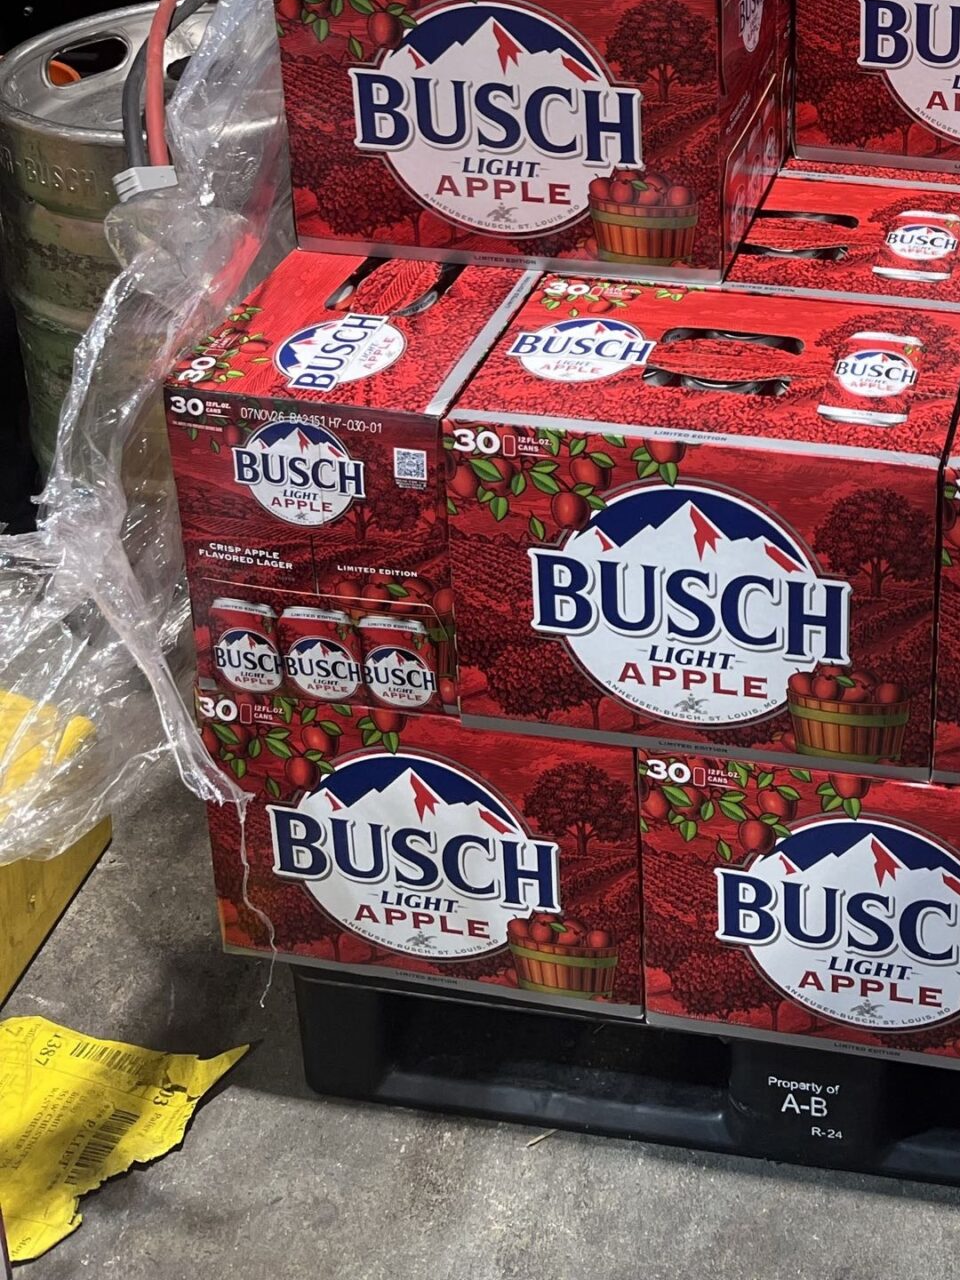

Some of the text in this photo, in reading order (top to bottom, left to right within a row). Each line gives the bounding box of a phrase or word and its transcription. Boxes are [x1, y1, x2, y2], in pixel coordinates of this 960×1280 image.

[354, 72, 638, 165] BUSCH
[462, 156, 540, 178] LIGHT
[435, 175, 572, 206] APPLE
[887, 232, 958, 250] BUSCH
[544, 281, 590, 295] 30
[293, 315, 386, 391] BUSCH
[362, 335, 396, 370] APPLE
[511, 334, 652, 362] BUSCH
[178, 356, 216, 383] 30
[539, 364, 600, 374] APPLE
[835, 361, 916, 384] BUSCH
[169, 396, 204, 417] 30
[240, 407, 285, 422] 07NOV26
[329, 418, 383, 434] H7-030-01
[453, 427, 500, 455] 30
[518, 444, 540, 453] CANS
[234, 448, 364, 496] BUSCH
[271, 497, 333, 513] APPLE
[282, 489, 320, 502] LIGHT
[199, 549, 293, 570] FLAVORED LAGER
[208, 542, 280, 560] CRISP APPLE
[337, 565, 418, 578] LIMITED EDITION
[536, 552, 849, 660] BUSCH
[215, 646, 282, 675] BUSCH
[648, 645, 735, 669] LIGHT
[234, 676, 274, 686] APPLE
[286, 656, 361, 683] BUSCH
[365, 665, 436, 691] BUSCH
[618, 662, 768, 699] APPLE
[307, 683, 348, 694] APPLE
[382, 691, 423, 702] APPLE
[198, 696, 238, 721] 30
[254, 713, 273, 721] CANS
[646, 758, 691, 784] 30
[707, 776, 728, 784] CANS
[272, 809, 557, 909] BUSCH
[380, 890, 459, 913] LIGHT
[354, 904, 490, 939] APPLE
[828, 956, 912, 980] LIGHT
[798, 970, 943, 1007] APPLE
[768, 1076, 840, 1095] Property of
[781, 1093, 828, 1117] A-B
[811, 1126, 843, 1139] R-24
